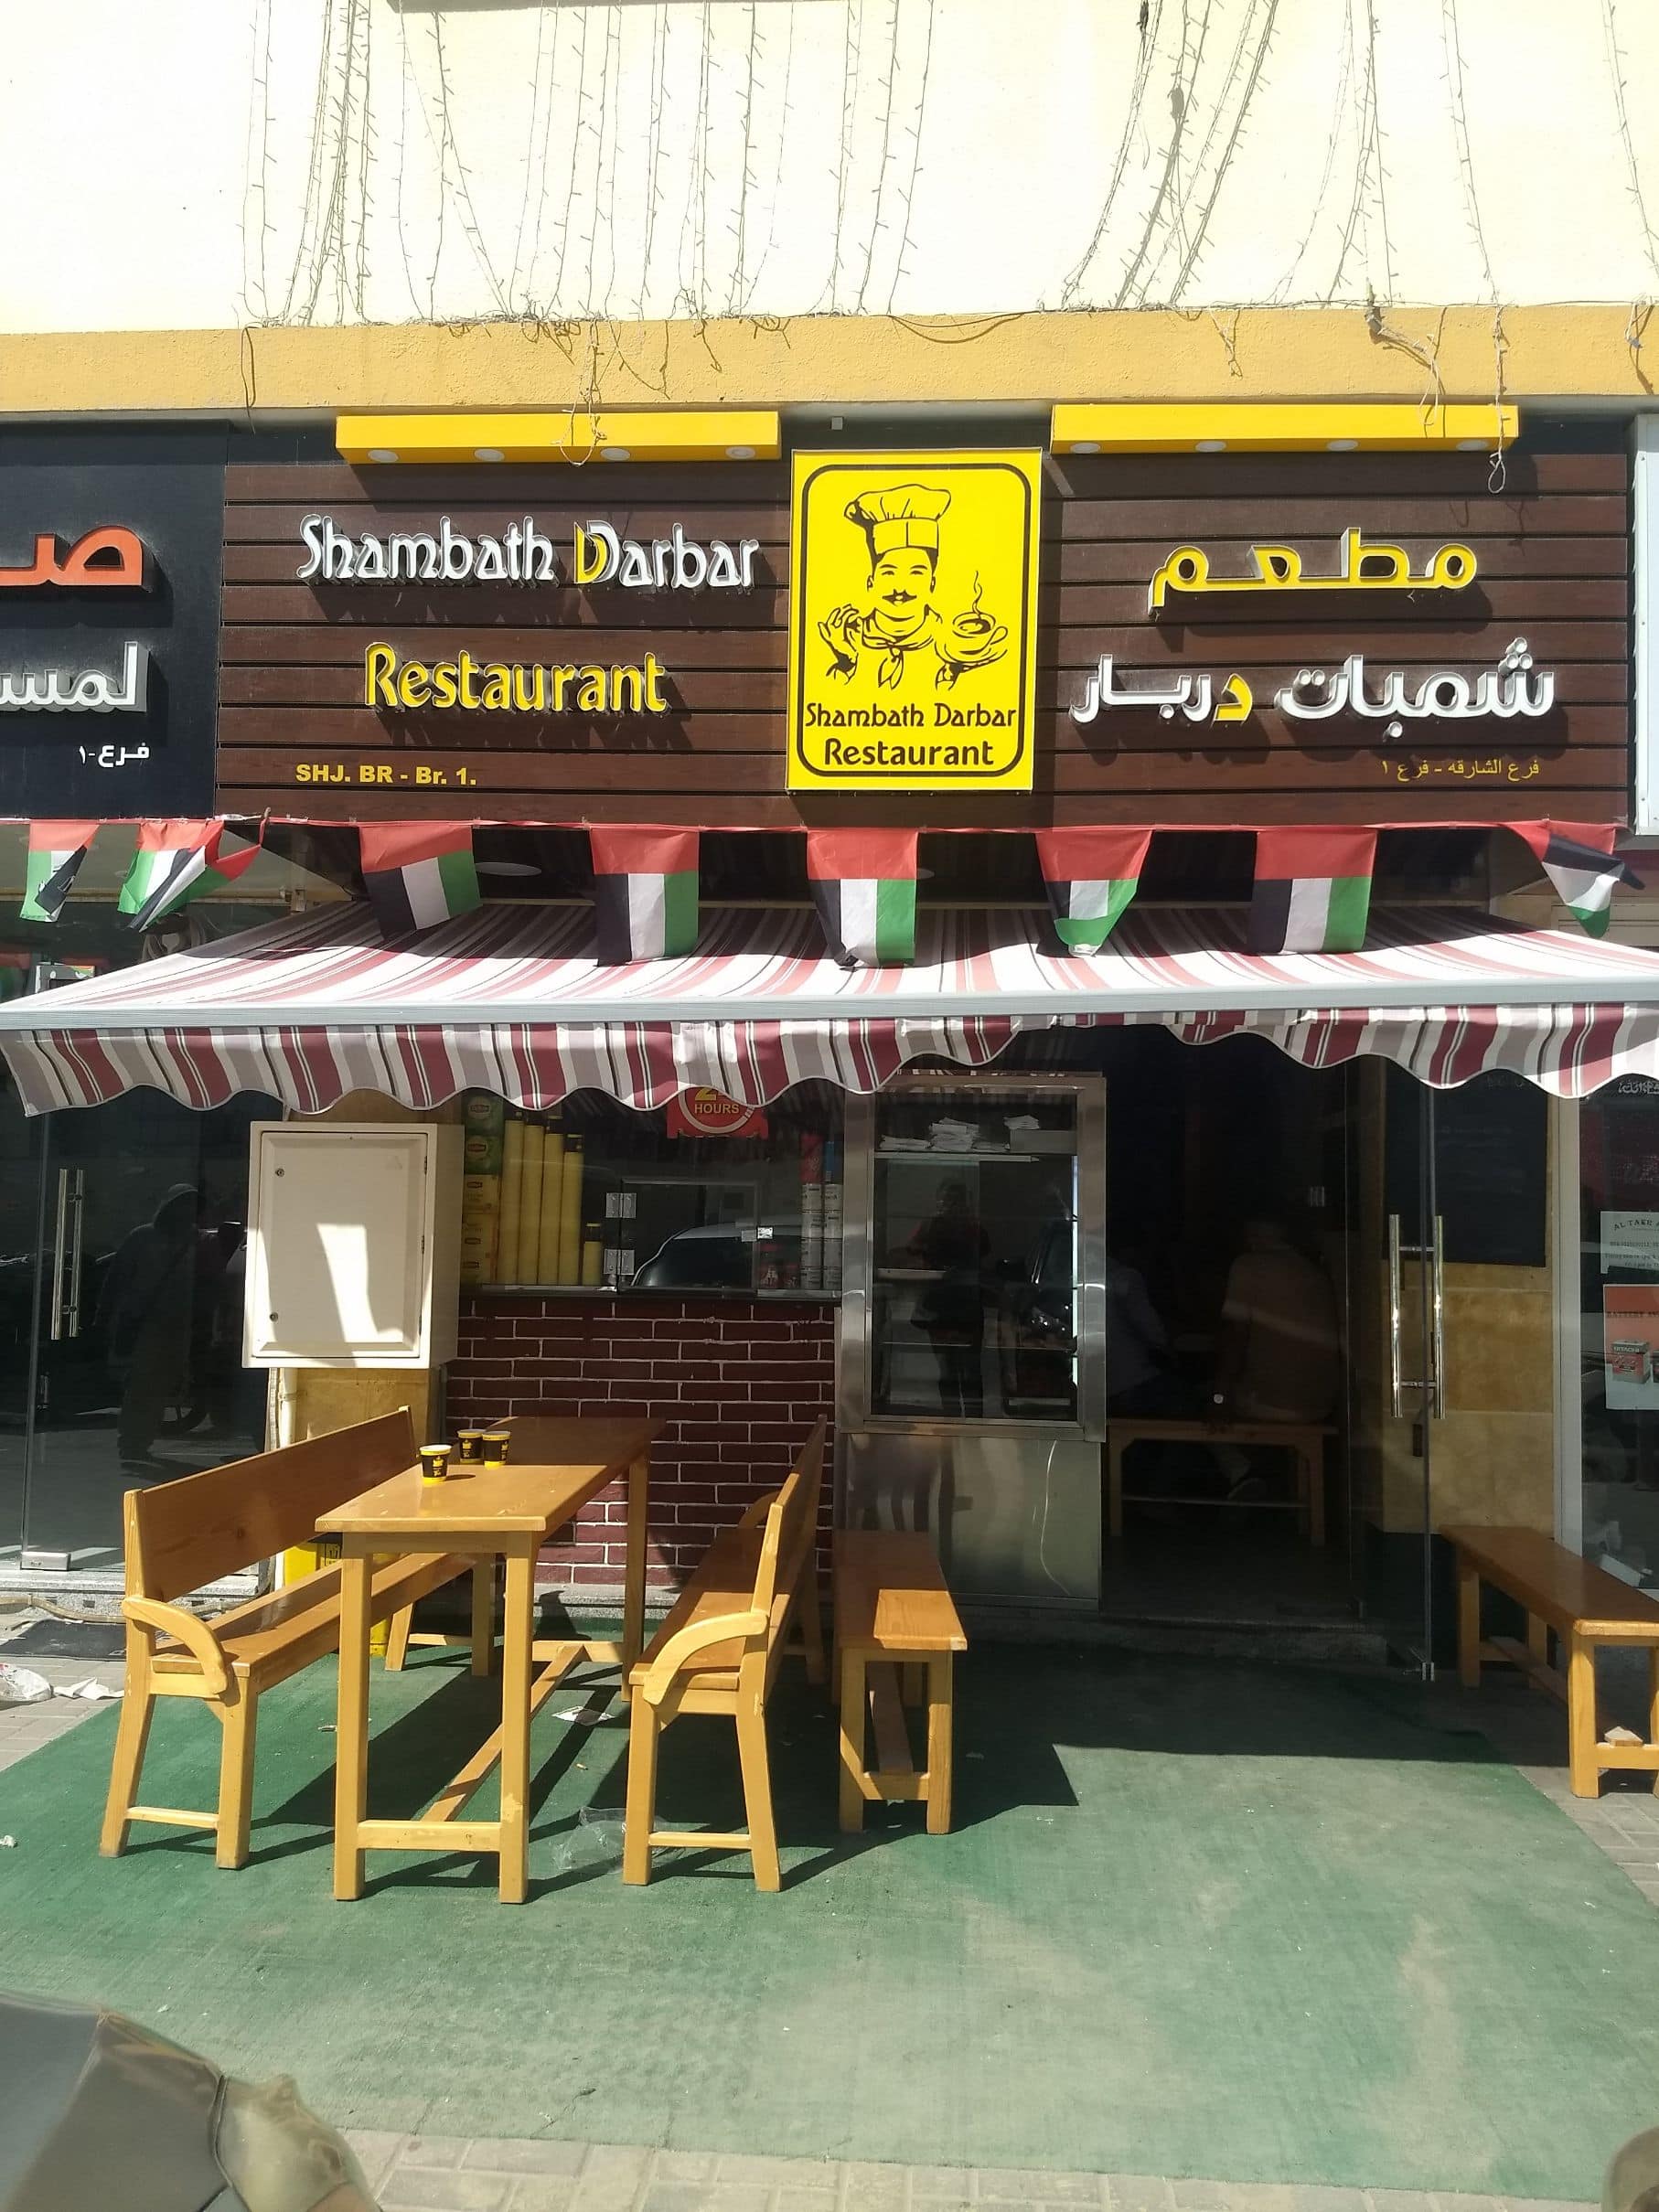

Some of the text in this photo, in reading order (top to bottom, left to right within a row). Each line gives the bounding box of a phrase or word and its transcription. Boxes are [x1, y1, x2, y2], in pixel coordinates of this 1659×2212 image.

[295, 514, 760, 589] Shambath Darbar
[1148, 527, 1478, 616] مطعم
[364, 641, 669, 713] Restaurant
[1069, 636, 1555, 739] شمبات دربار
[805, 702, 1018, 728] Shambath Darbar
[824, 737, 995, 766] Restaurant
[295, 764, 351, 783] SHJ.
[359, 765, 393, 784] BR
[415, 766, 448, 785] Br.
[455, 767, 477, 785] 1.
[1397, 759, 1429, 782] فرع
[1507, 759, 1540, 782] فرع
[694, 1103, 740, 1115] HOURS
